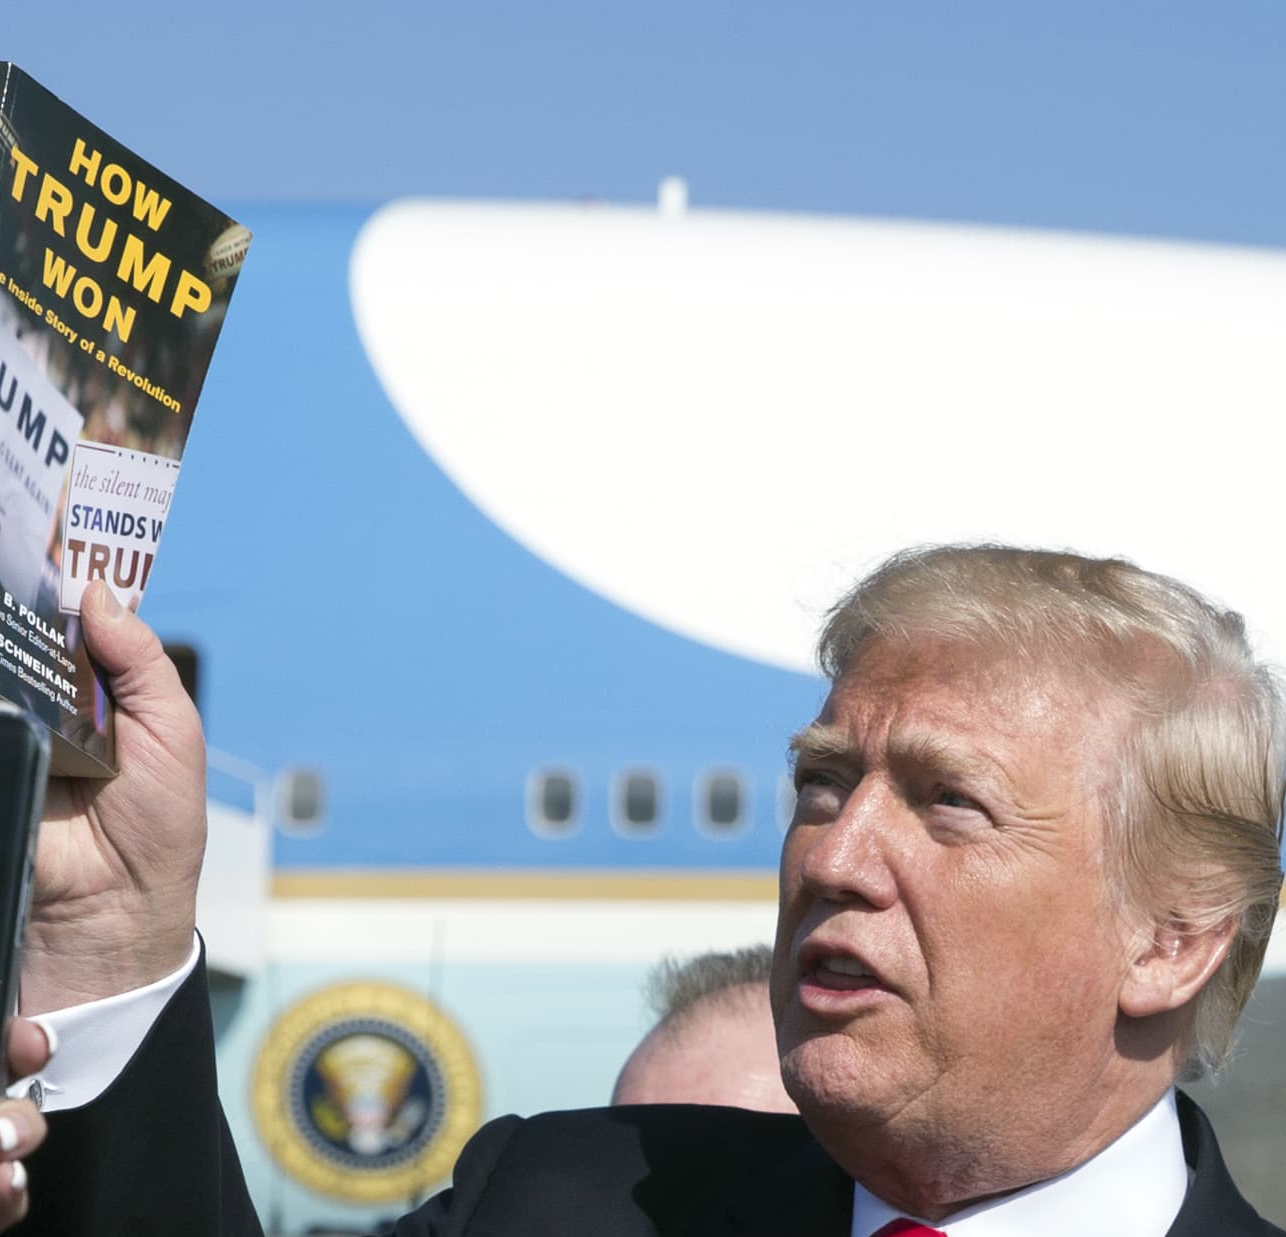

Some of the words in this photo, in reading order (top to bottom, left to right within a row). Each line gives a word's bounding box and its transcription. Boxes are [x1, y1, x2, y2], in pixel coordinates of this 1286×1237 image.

[69, 137, 173, 232] HOW
[10, 145, 213, 319] TRUMP
[42, 247, 137, 344] WON
[8, 278, 43, 316] Inside
[45, 309, 78, 344] Story
[80, 338, 95, 354] of
[96, 350, 106, 363] a
[108, 355, 181, 414] Revolution
[75, 465, 98, 490] the
[99, 470, 141, 499] silent
[70, 504, 147, 540] STANDS
[3, 591, 15, 611] B.
[19, 604, 65, 648] POLLAK
[6, 613, 28, 637] Senior
[17, 665, 56, 702] Bestselling
[56, 693, 78, 716] Author
